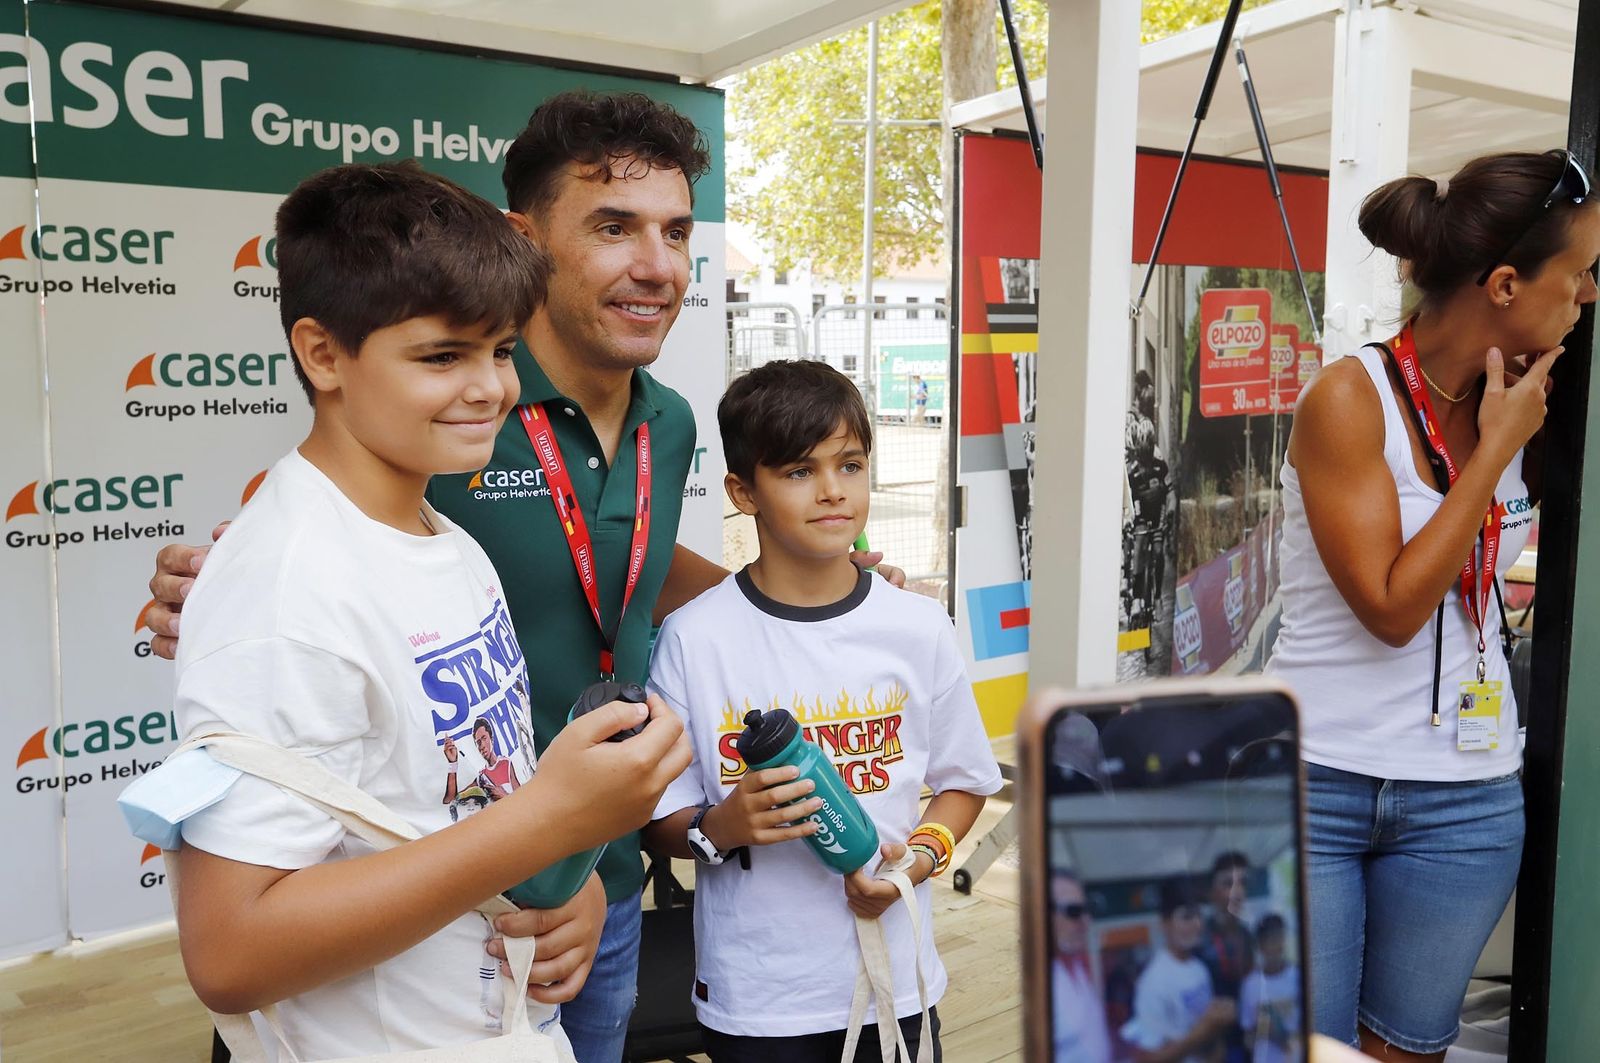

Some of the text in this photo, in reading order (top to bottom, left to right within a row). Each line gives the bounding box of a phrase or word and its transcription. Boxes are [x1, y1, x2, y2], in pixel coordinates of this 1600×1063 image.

[251, 102, 400, 163] Grupo
[31, 224, 174, 265] caser
[0, 275, 176, 298] Grupo Helvetia
[160, 353, 287, 387] caser
[125, 398, 288, 422] Grupo Helvetia
[483, 468, 544, 487] caser
[43, 473, 184, 514] caser
[474, 490, 507, 501] Grupo
[5, 519, 185, 550] Grupo Helvetia
[1501, 520, 1522, 530] Grupo
[16, 771, 93, 793] Grupo
[822, 798, 847, 833] seguros
